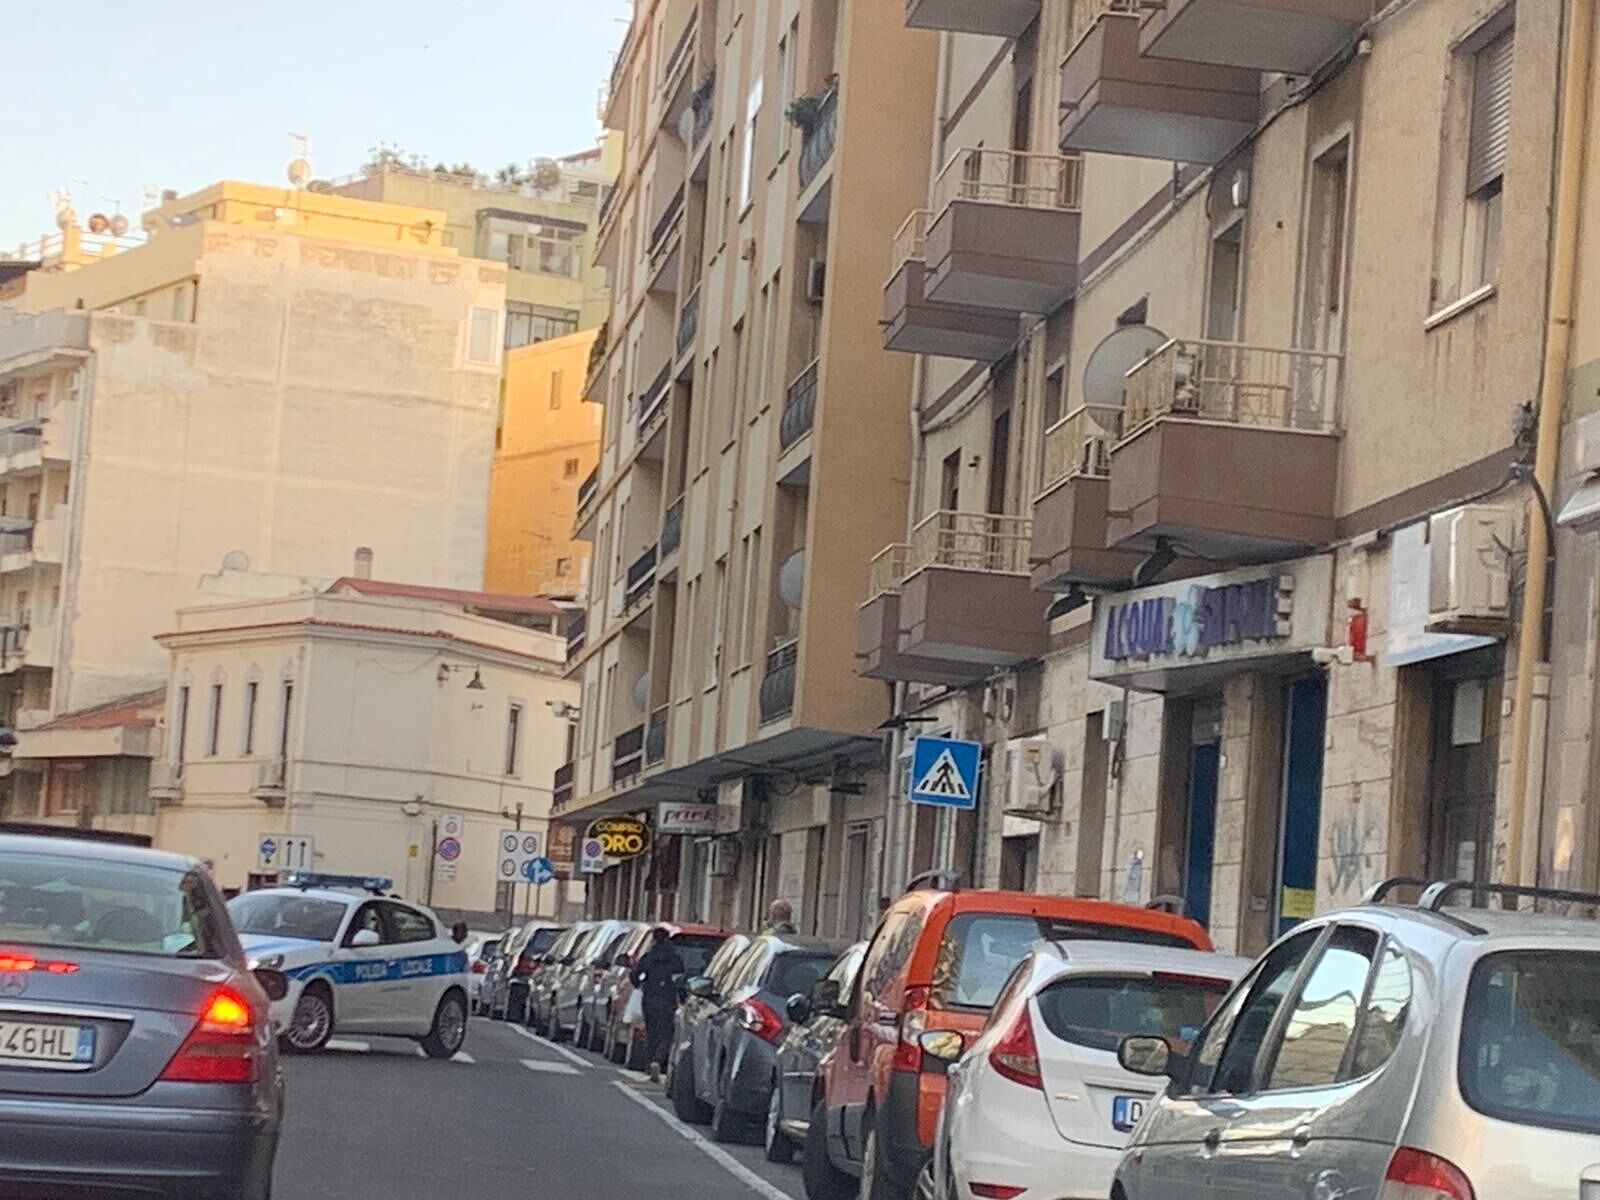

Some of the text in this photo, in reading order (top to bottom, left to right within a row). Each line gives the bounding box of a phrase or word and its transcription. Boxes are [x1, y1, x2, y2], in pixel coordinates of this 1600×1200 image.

[596, 821, 644, 834] COMPRO
[599, 833, 644, 852] ORO
[0, 1026, 72, 1056] 46HL
